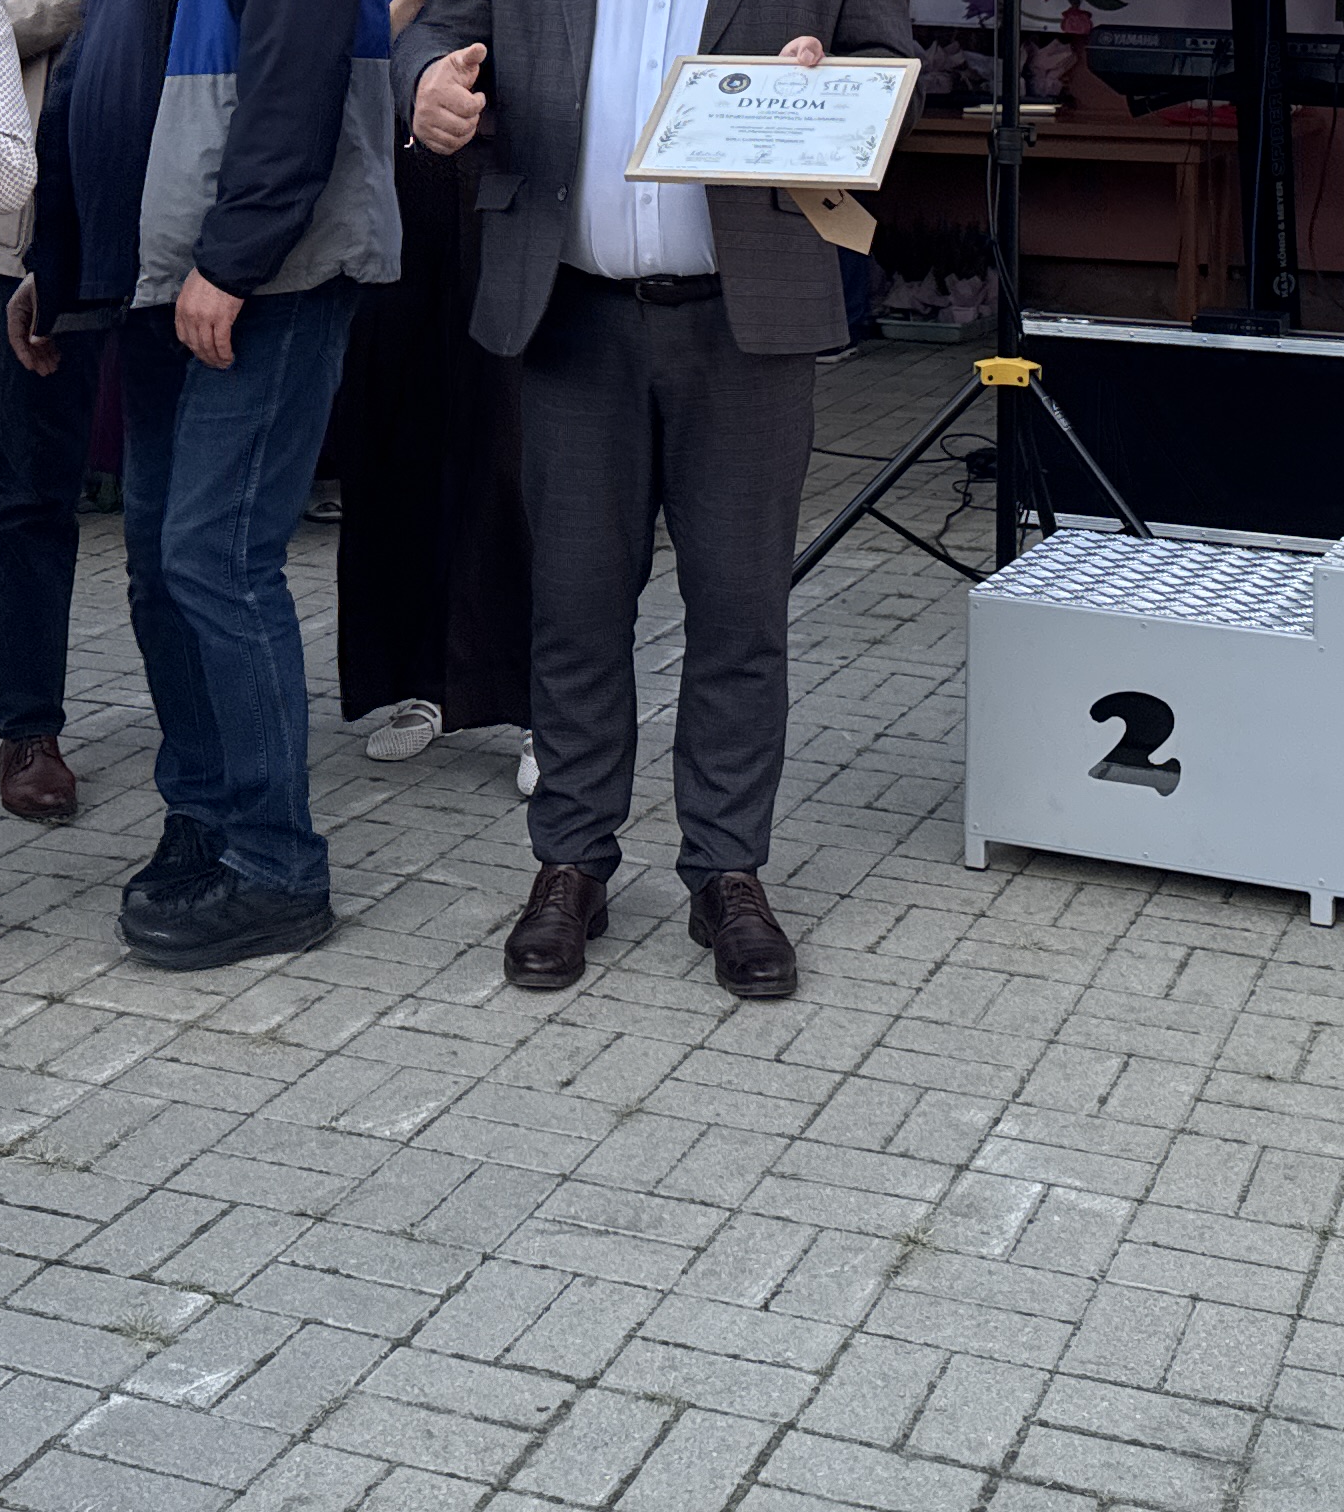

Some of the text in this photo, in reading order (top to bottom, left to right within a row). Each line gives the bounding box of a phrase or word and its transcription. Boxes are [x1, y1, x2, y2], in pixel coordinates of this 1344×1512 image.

[1113, 33, 1160, 46] YAMAHA
[737, 97, 826, 110] DYPLOM
[1267, 40, 1286, 177] SPIDER PRO
[1275, 181, 1285, 220] MEYER
[1089, 690, 1181, 797] 2
